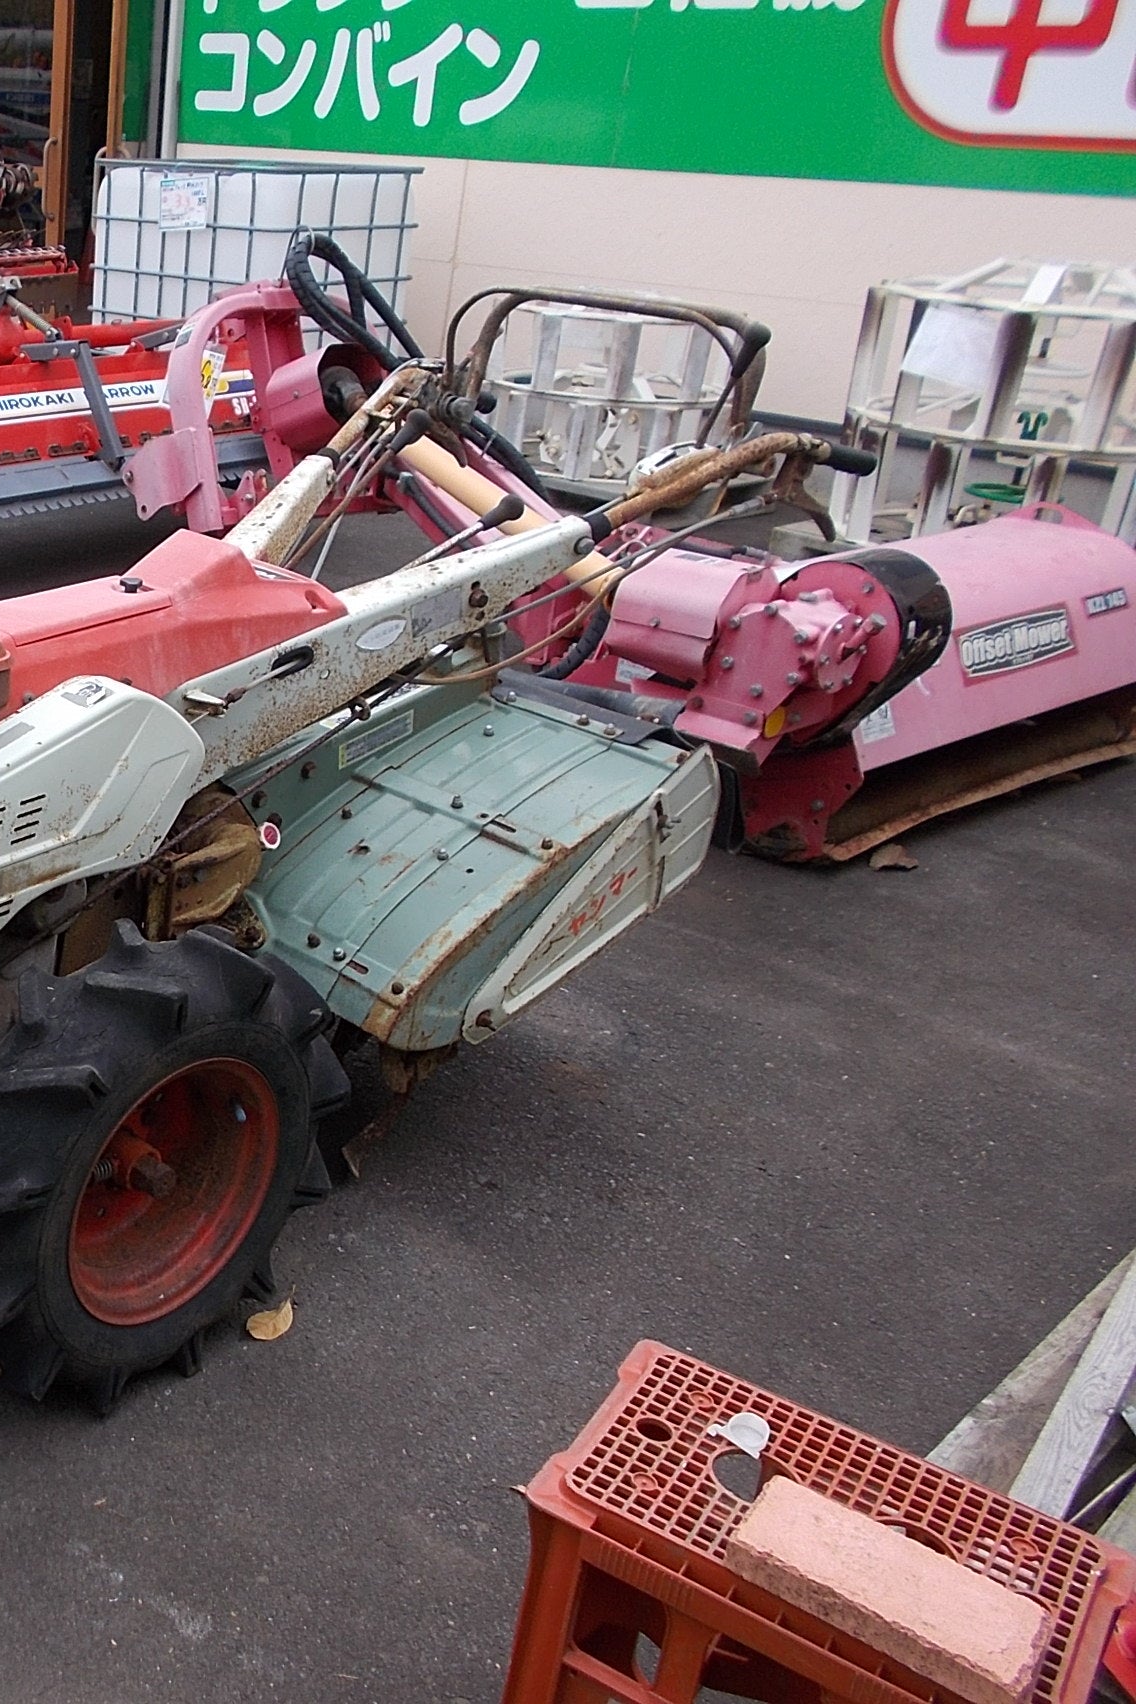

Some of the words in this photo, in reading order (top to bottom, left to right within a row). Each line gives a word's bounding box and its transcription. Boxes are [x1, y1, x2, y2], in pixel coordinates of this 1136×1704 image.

[194, 21, 540, 127] コンバイン
[962, 629, 1013, 668] Offset
[1013, 618, 1068, 655] Mower
